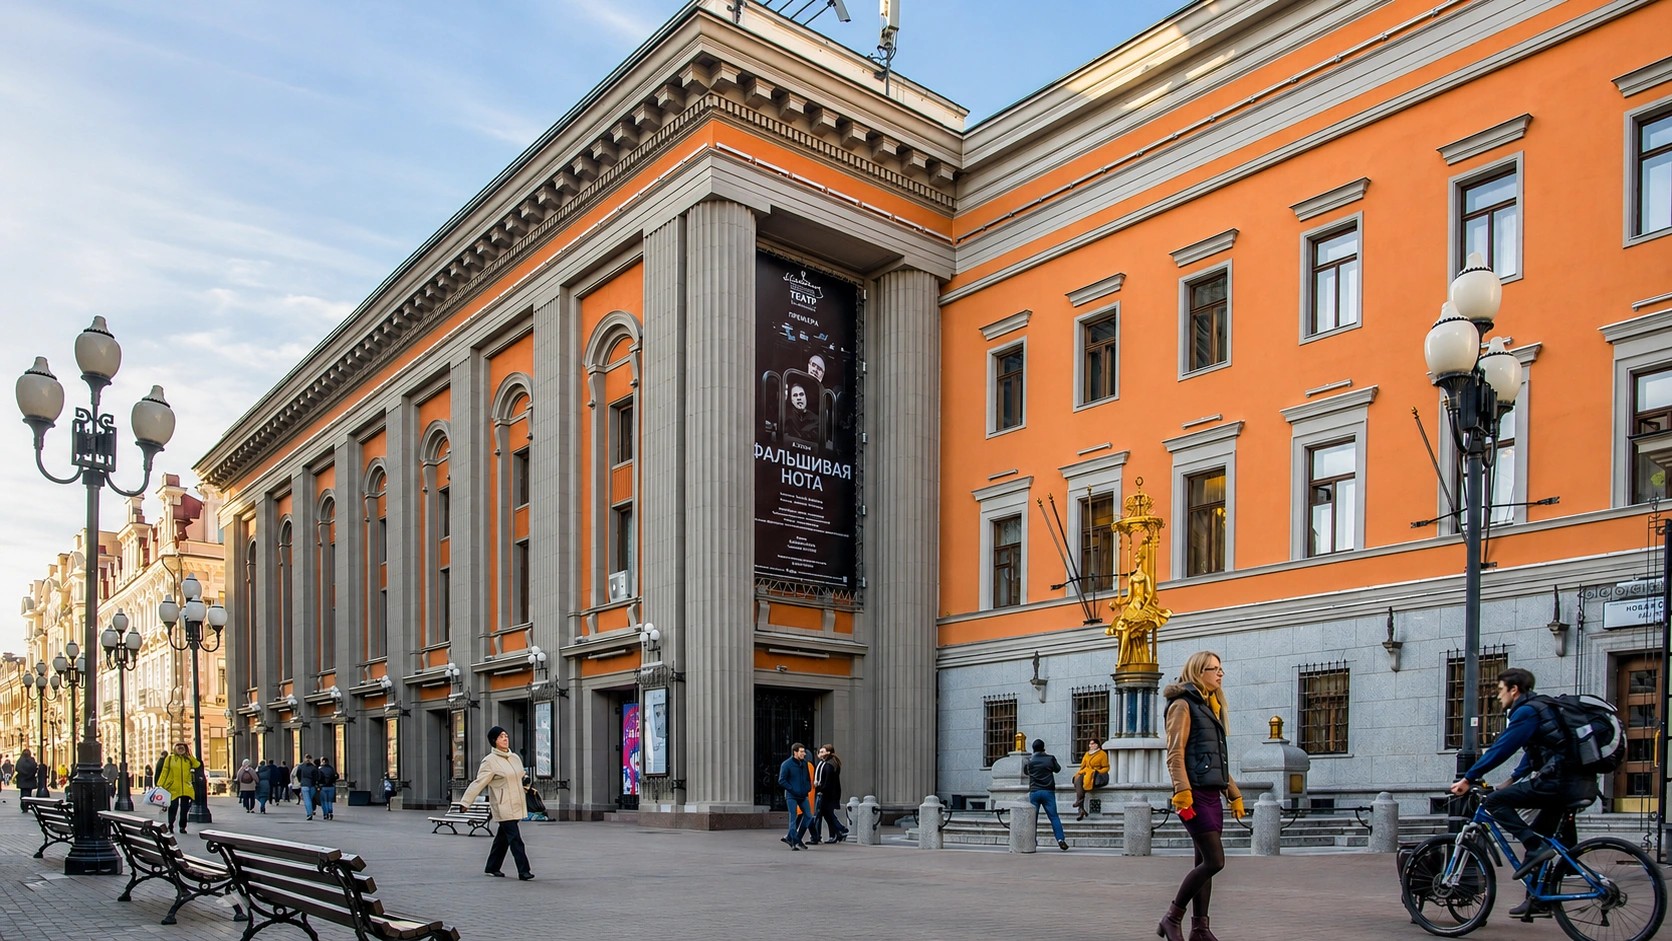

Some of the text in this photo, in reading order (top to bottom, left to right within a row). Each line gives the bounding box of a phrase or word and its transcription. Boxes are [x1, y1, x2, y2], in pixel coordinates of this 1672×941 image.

[790, 290, 817, 305] ТЕАТР
[754, 442, 851, 480] ФАЛЬШИВАЯ
[781, 467, 824, 492] НОТА
